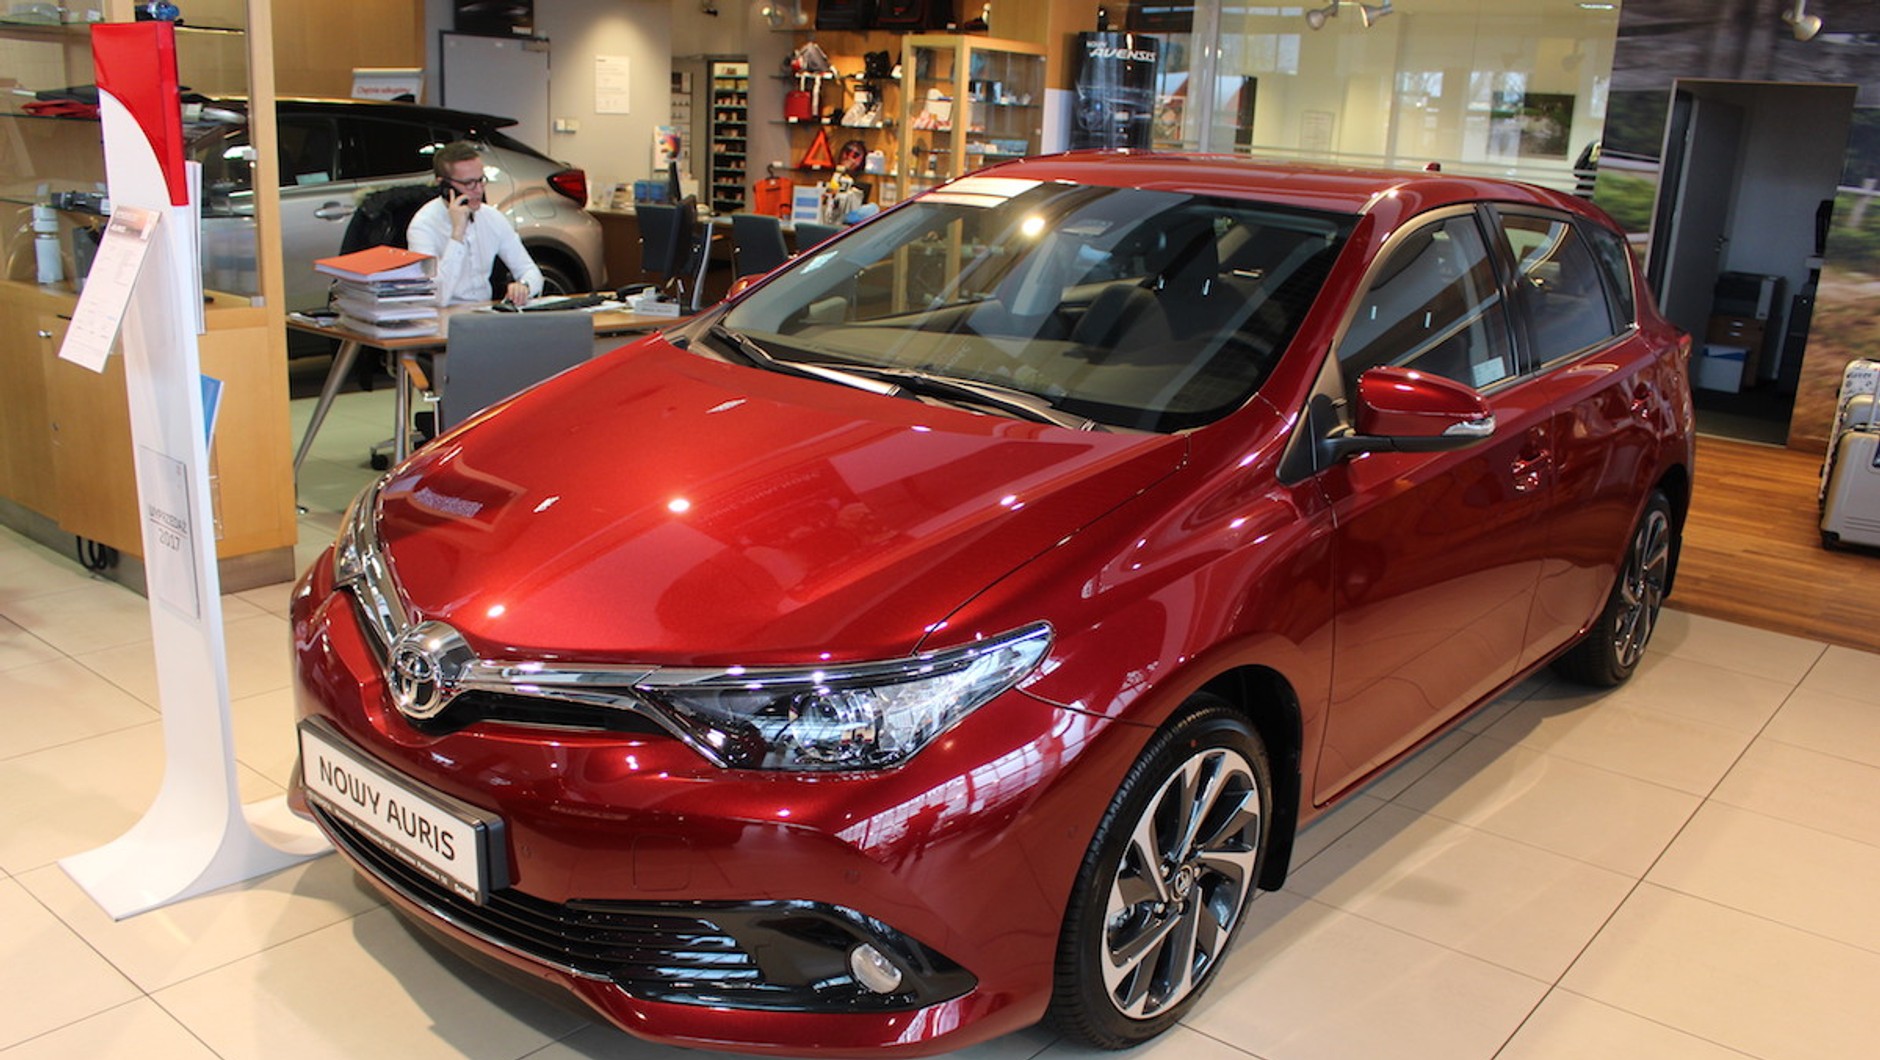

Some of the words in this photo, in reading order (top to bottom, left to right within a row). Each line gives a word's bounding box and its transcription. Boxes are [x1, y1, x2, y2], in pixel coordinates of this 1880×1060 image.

[1089, 48, 1156, 62] AVENSIS
[319, 755, 380, 814] NOWY
[387, 799, 455, 861] AURIS
